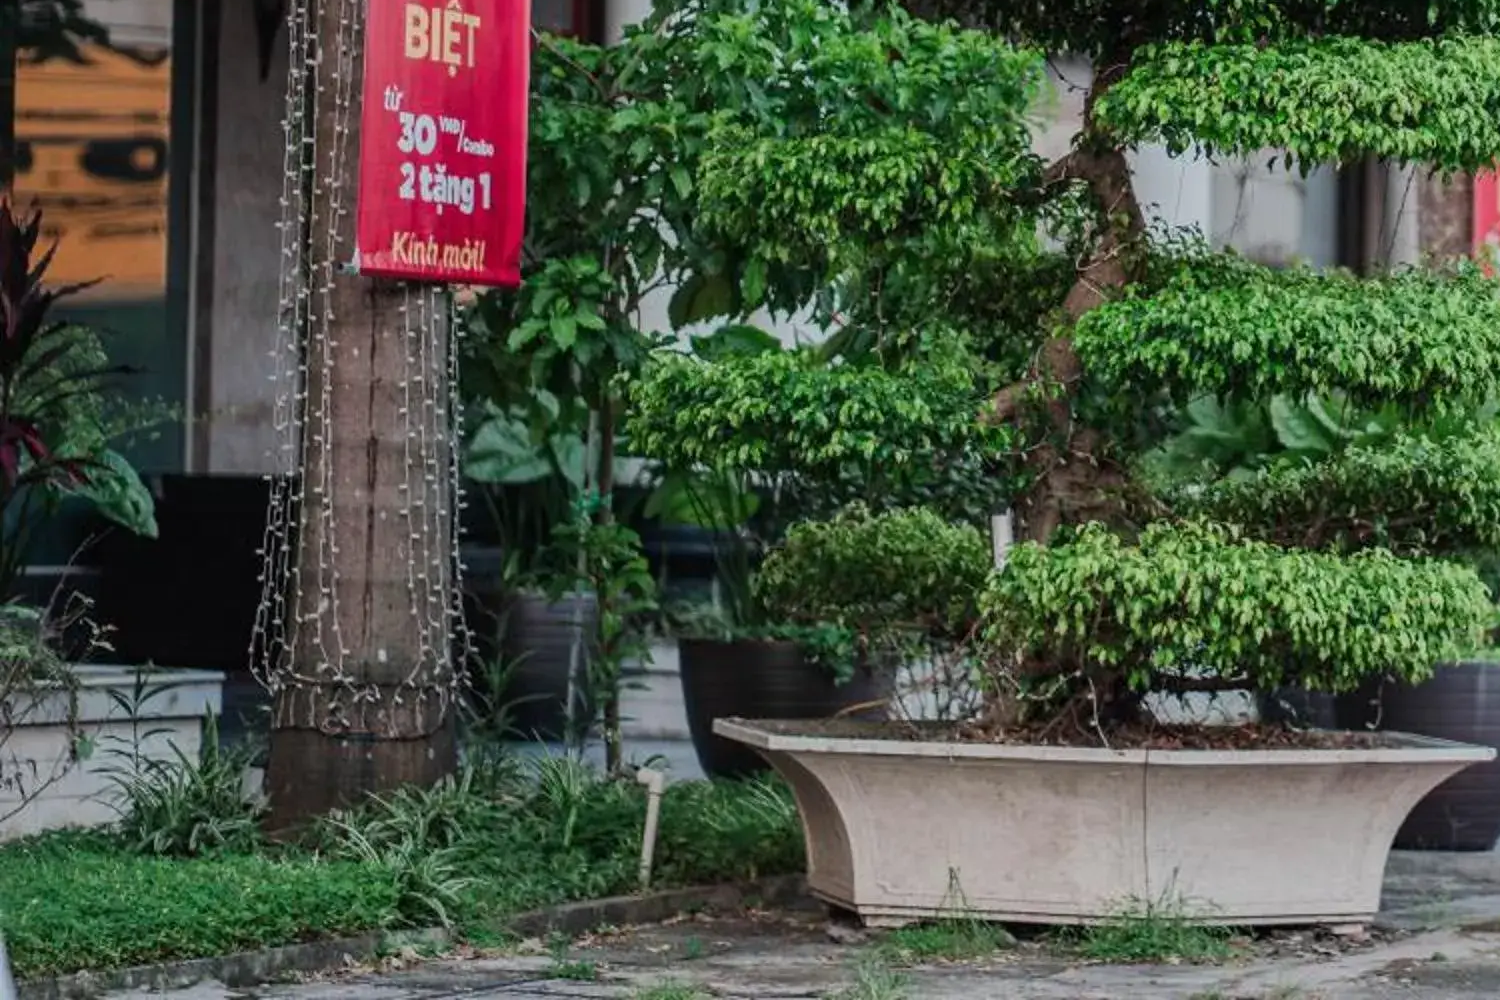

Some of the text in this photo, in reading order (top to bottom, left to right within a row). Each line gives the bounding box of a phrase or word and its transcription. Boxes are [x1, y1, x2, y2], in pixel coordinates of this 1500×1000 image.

[397, 111, 437, 156] 30
[399, 162, 491, 216] 2 tặng 1
[391, 230, 439, 267] Kính
